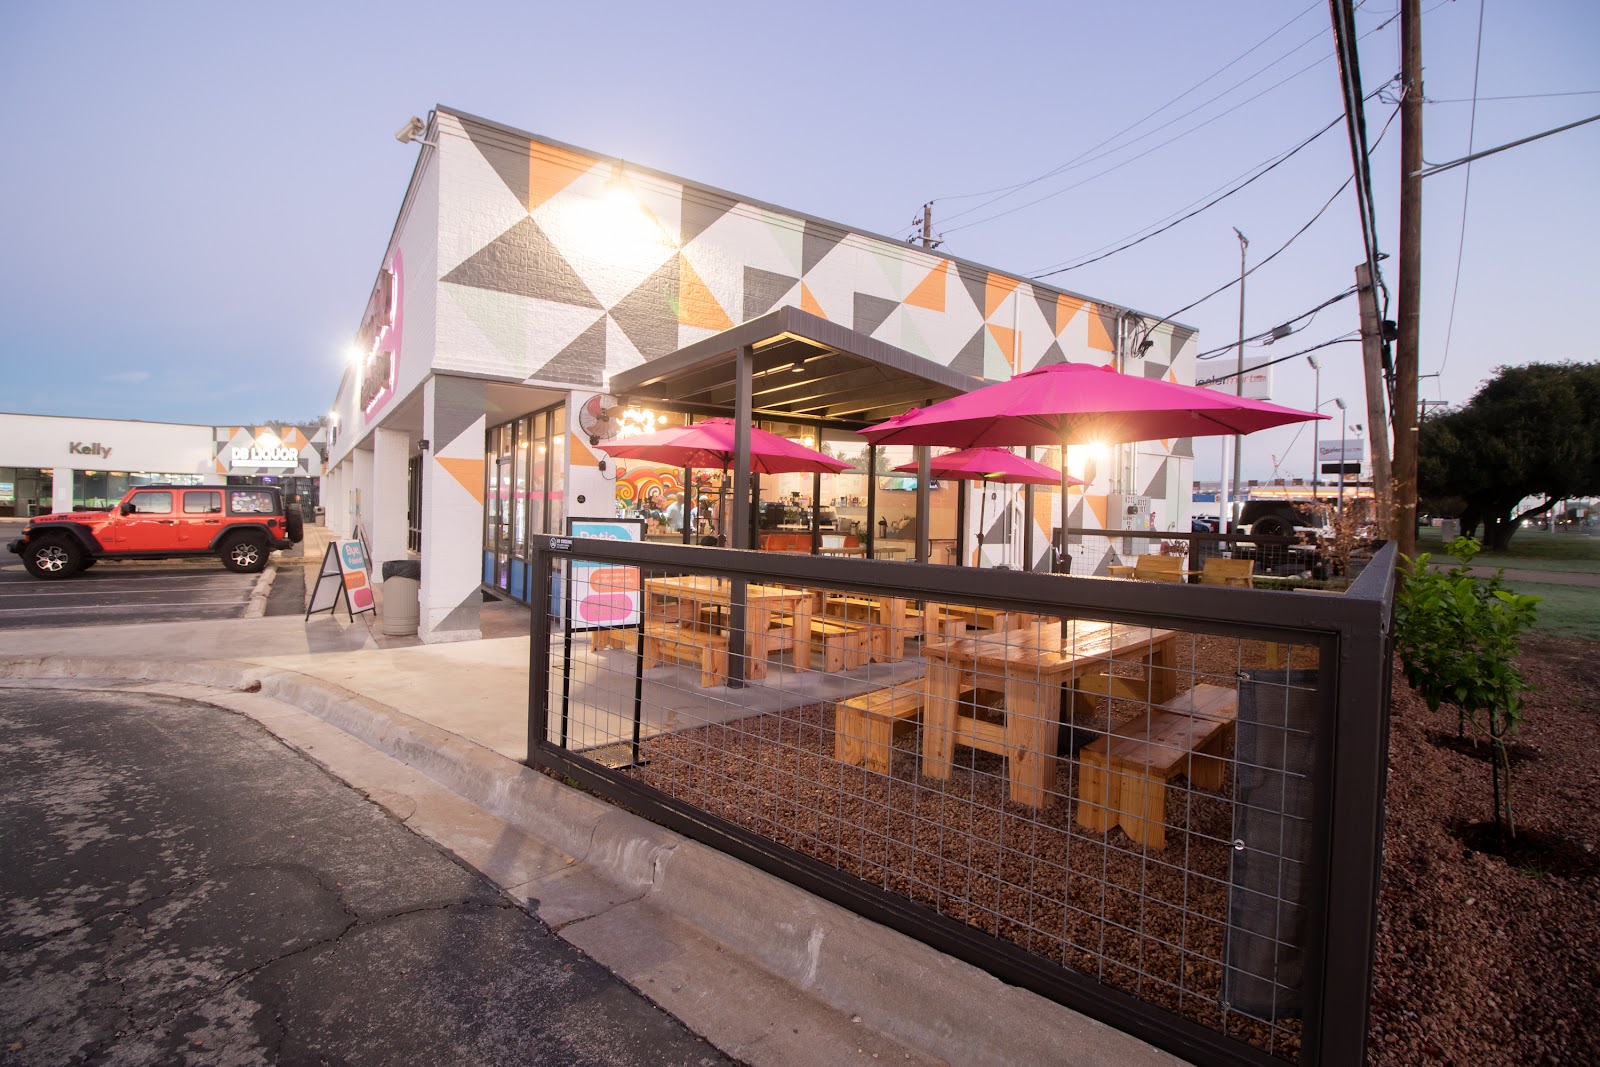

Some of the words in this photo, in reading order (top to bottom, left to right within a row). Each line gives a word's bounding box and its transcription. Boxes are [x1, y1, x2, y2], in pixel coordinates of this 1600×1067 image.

[69, 441, 112, 459] Kelly
[231, 447, 249, 460] DB
[251, 447, 298, 461] LIQUOR
